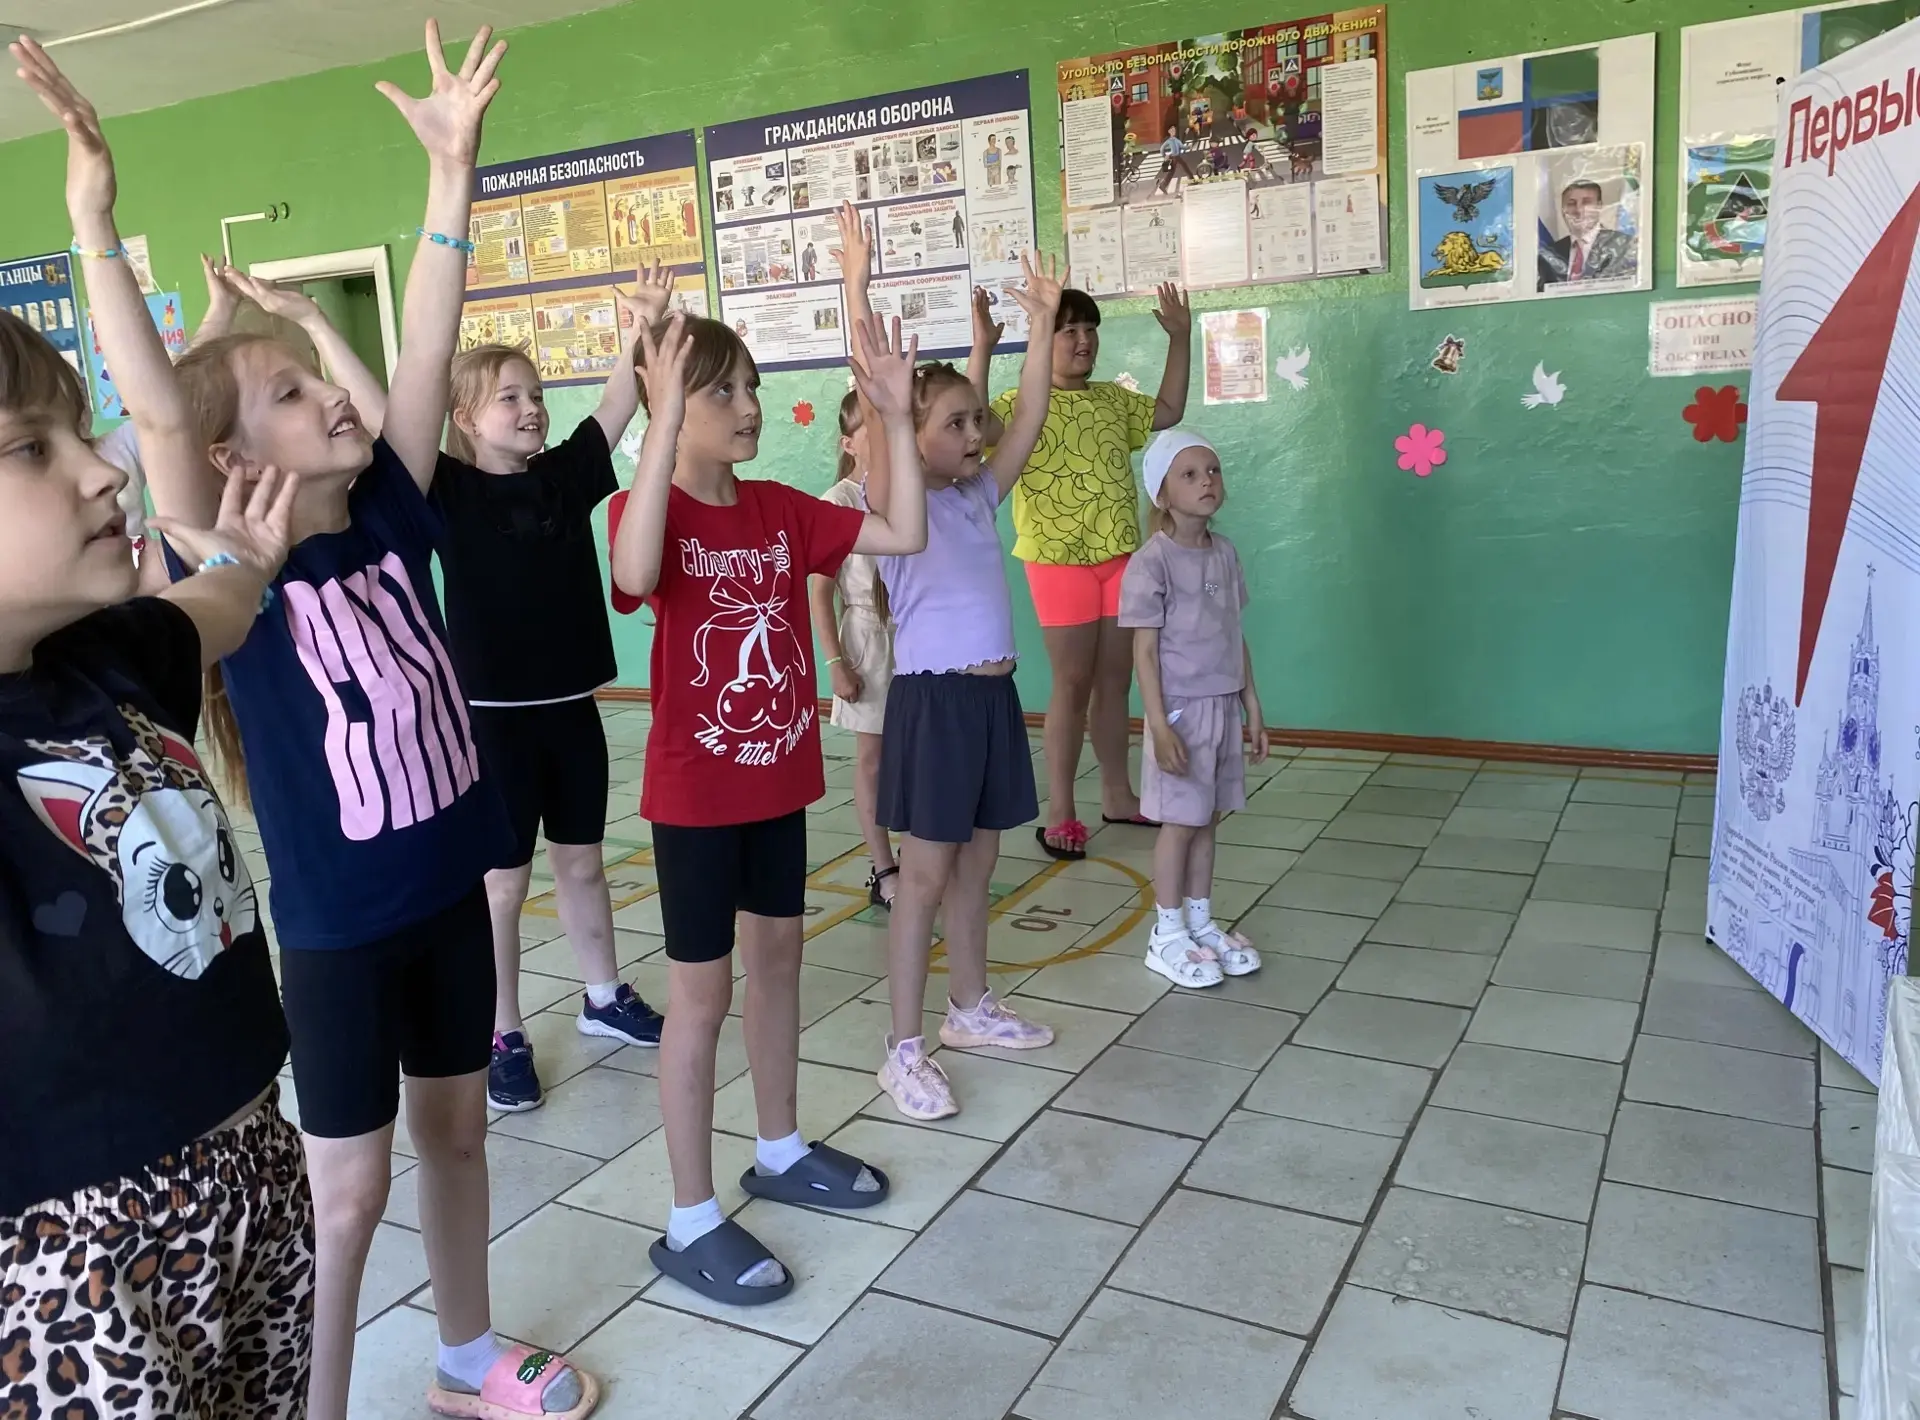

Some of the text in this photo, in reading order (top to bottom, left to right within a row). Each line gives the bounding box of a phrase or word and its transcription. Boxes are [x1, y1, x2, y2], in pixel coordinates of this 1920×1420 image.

[1062, 16, 1377, 80] УГОЛОК ПО БЕЗОПАСНОСТИ ДОРОЖНОГО ДВИЖЕНИЯ
[764, 95, 954, 146] ГРАЖДАНСКАЯ ОБОРОНА
[1784, 66, 1920, 178] Первы
[482, 150, 645, 193] ПОЖАРНАЯ БЕЗОПАСНОСТЬ
[1664, 310, 1752, 330] ОПАСНО
[1692, 334, 1720, 346] ПРИ
